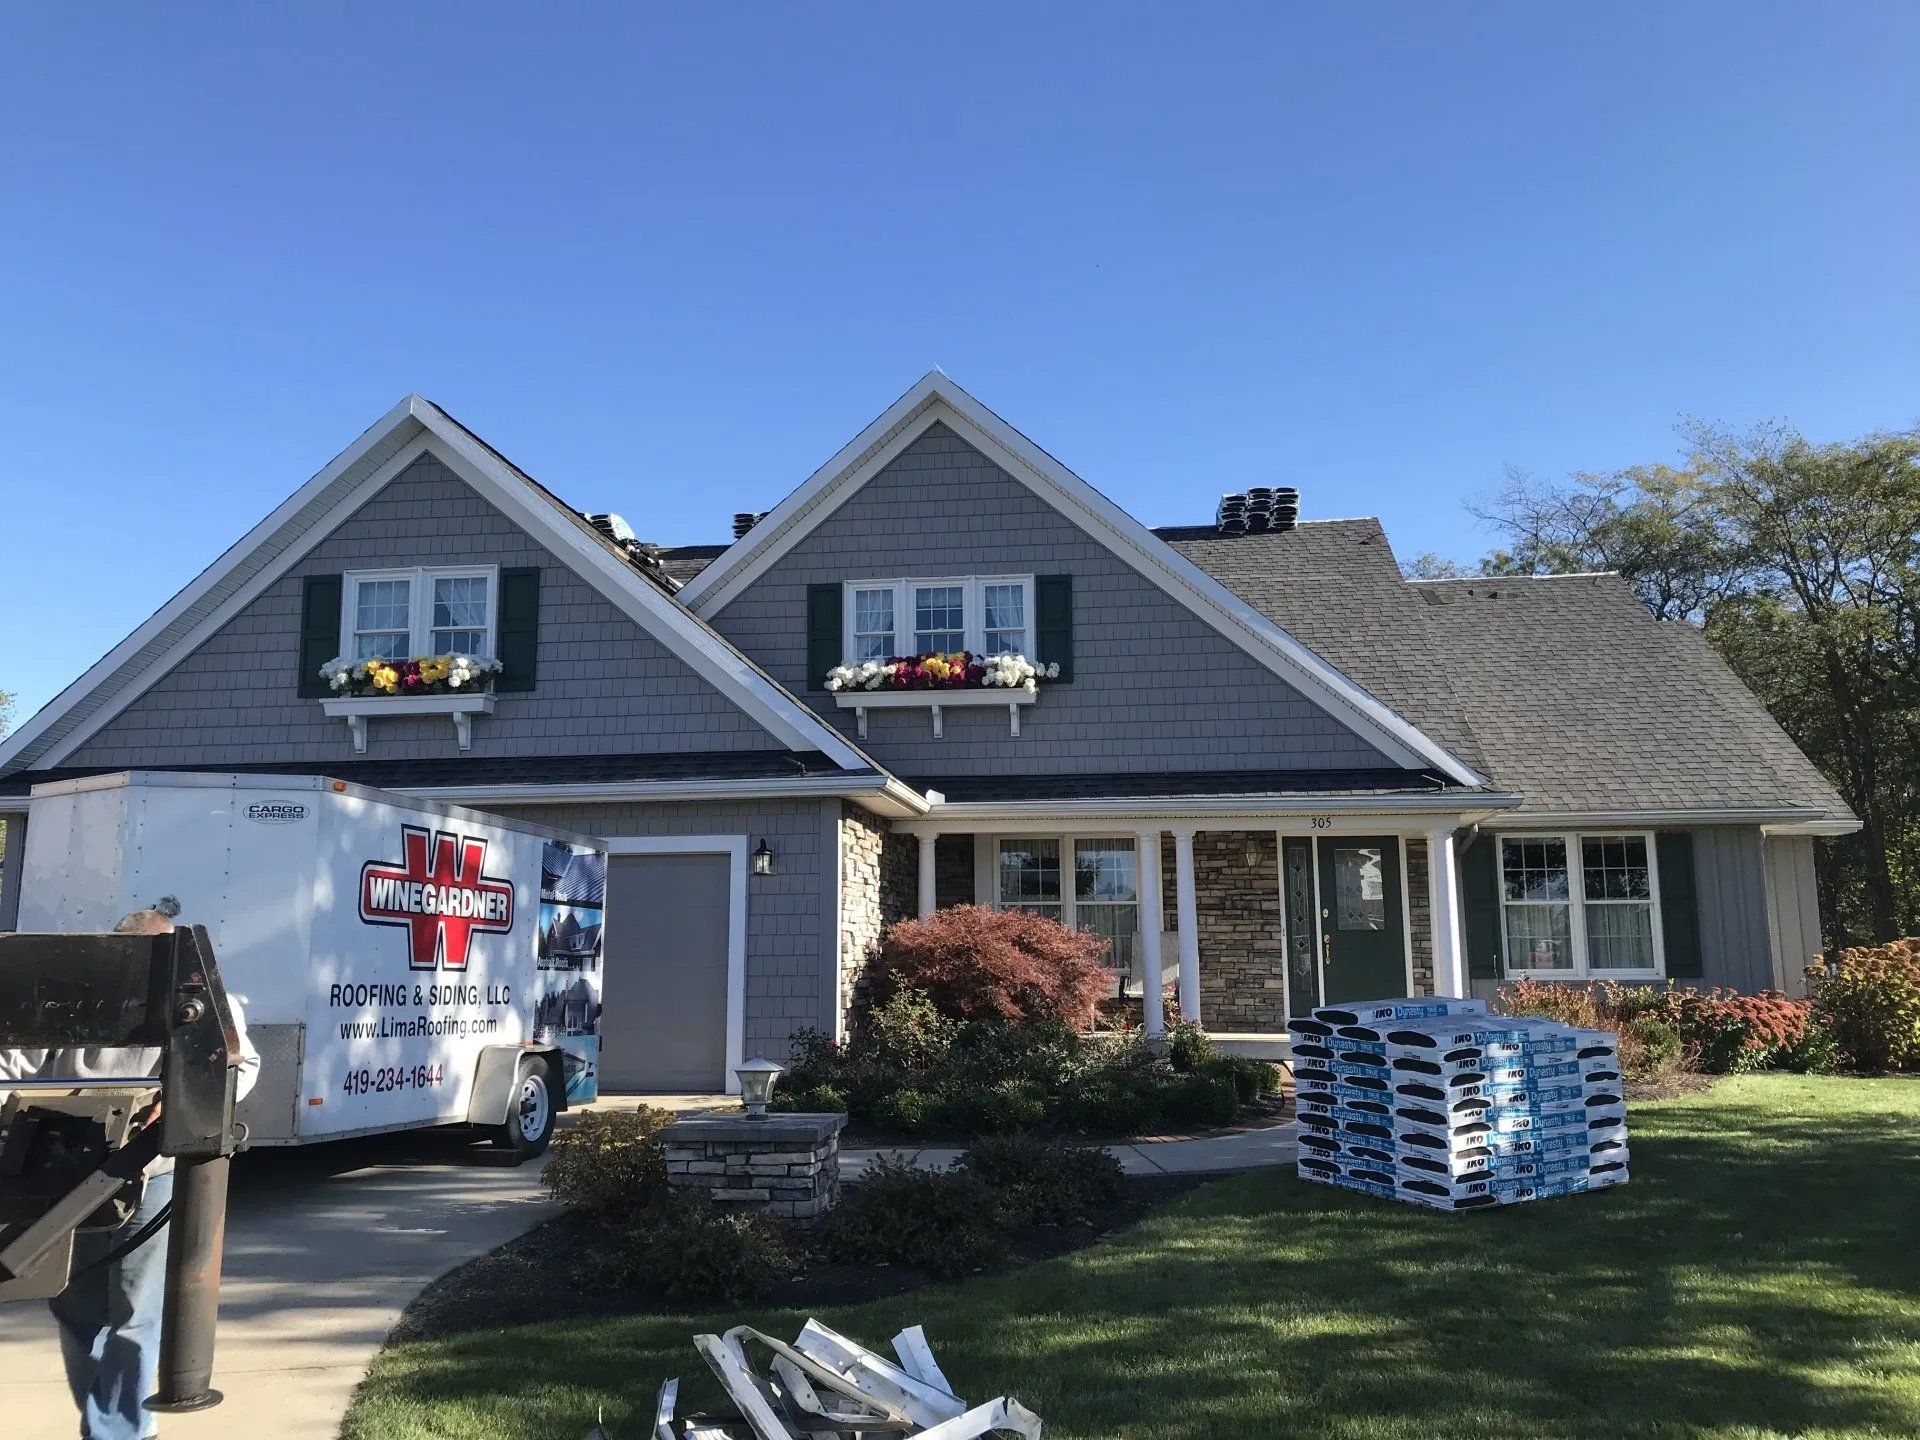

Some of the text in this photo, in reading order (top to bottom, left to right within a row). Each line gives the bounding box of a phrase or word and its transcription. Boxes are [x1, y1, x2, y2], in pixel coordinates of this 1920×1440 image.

[1310, 817, 1331, 828] 305
[369, 875, 508, 921] WINEGARDNER
[330, 984, 510, 1008] ROOFING & SIDING, LLC
[1376, 1008, 1392, 1018] IKO
[1397, 1006, 1424, 1018] Dynasty
[340, 1016, 497, 1040] www.LimaRoofing.com
[1303, 1034, 1322, 1043] IKO
[1328, 1038, 1356, 1050] Dynasty
[1454, 1034, 1472, 1044] IKO
[1477, 1032, 1504, 1044] Dynasty
[1525, 1042, 1551, 1054] Dynasty
[1307, 1059, 1326, 1068] IKO
[1331, 1062, 1361, 1075] Dynasty
[1459, 1059, 1476, 1068] IKO
[1508, 1070, 1524, 1078] IKO
[1530, 1067, 1556, 1080] Dynasty
[343, 1064, 444, 1096] 419-234-1644
[1310, 1081, 1328, 1090] IKO
[1334, 1084, 1364, 1099] Dynasty
[1462, 1086, 1480, 1097] IKO
[1532, 1090, 1558, 1104] Dynasty
[1310, 1103, 1328, 1113] IKO
[1334, 1108, 1364, 1122] Dynasty
[1535, 1117, 1562, 1128] Dynasty
[1311, 1125, 1330, 1135] IKO
[1466, 1136, 1484, 1146] IKO
[1514, 1142, 1532, 1152] IKO
[1536, 1140, 1562, 1152] Dynasty
[1312, 1148, 1330, 1158] IKO
[1467, 1158, 1484, 1168] IKO
[1490, 1156, 1518, 1166] Dynasty
[1312, 1169, 1330, 1180] IKO
[1516, 1164, 1534, 1174] IKO
[1539, 1162, 1565, 1175] Dynasty
[1468, 1182, 1486, 1193] IKO
[1492, 1180, 1520, 1191] Dynasty
[1516, 1188, 1532, 1198] IKO
